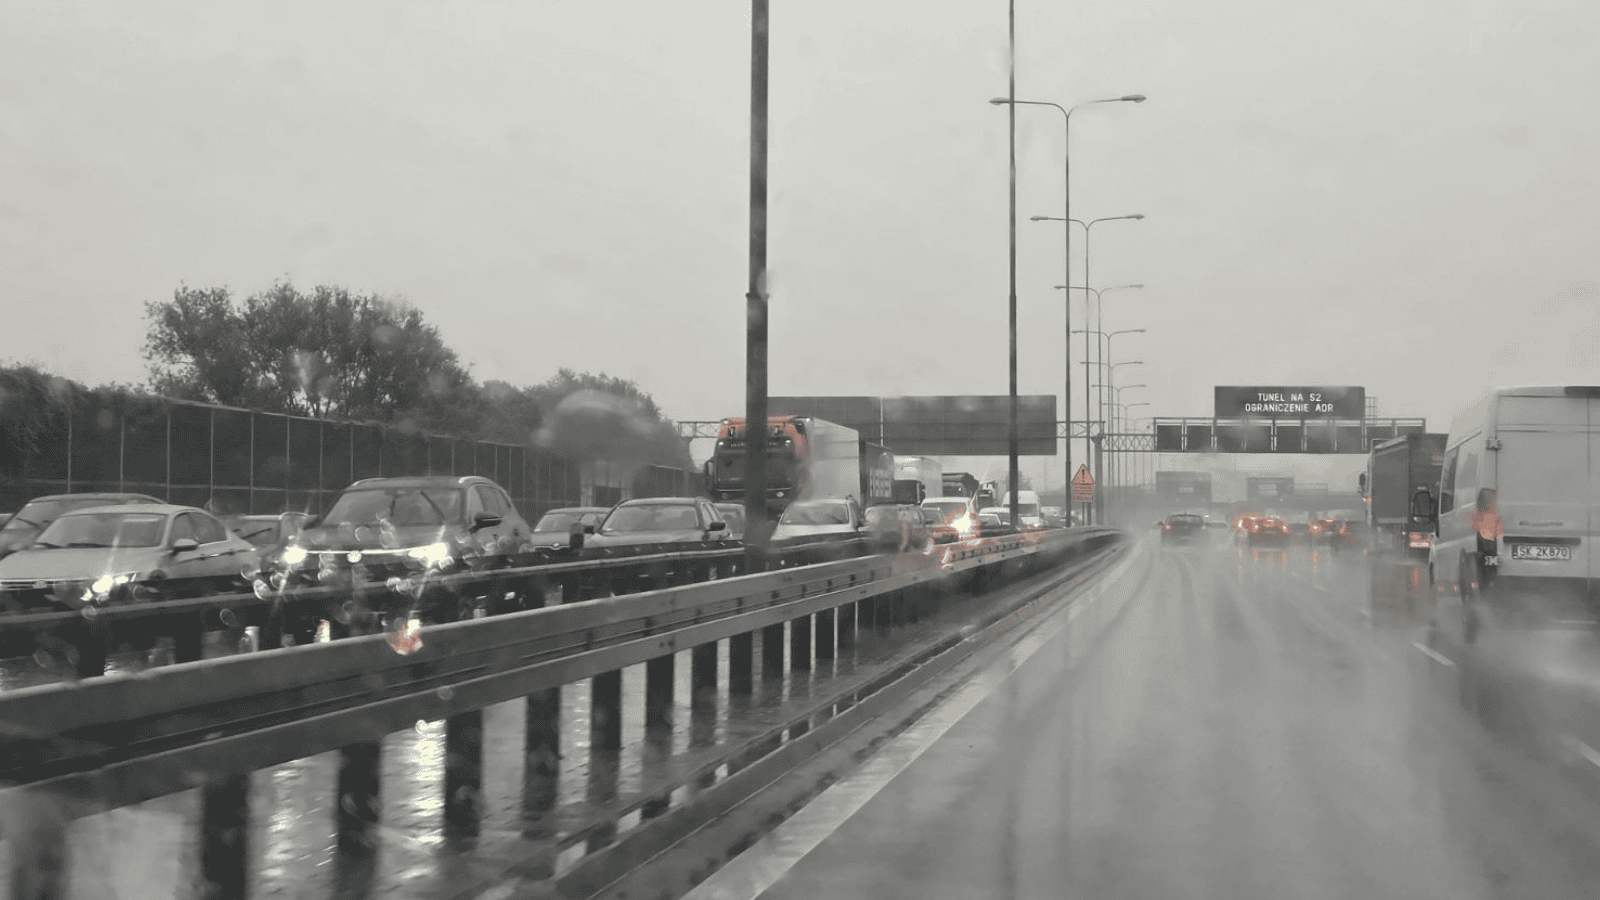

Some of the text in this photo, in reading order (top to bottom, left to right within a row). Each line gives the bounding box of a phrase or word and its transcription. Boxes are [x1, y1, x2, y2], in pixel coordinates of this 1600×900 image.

[1258, 393, 1321, 401] TUNEL NA S2
[1245, 403, 1333, 412] OGRANICZENIE ADR
[1520, 546, 1568, 557] SK 2K870
